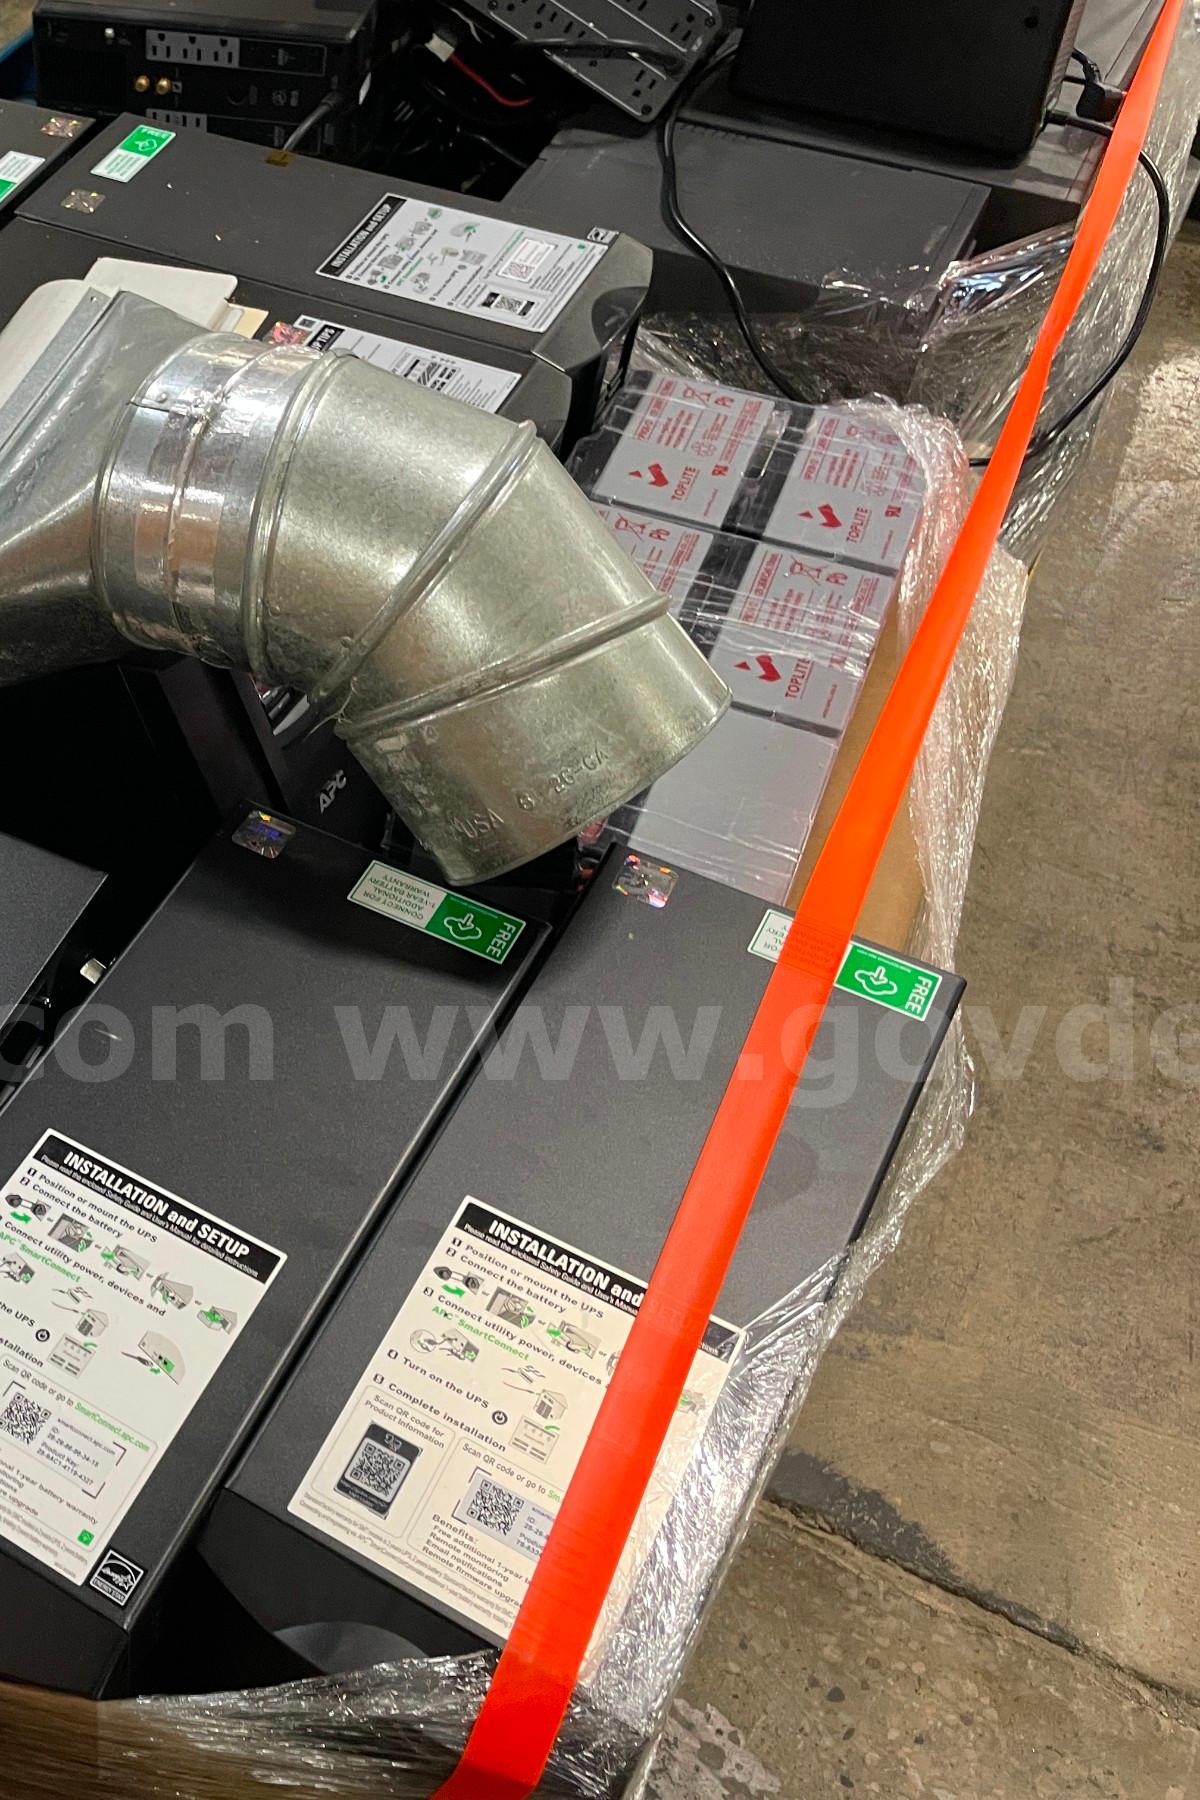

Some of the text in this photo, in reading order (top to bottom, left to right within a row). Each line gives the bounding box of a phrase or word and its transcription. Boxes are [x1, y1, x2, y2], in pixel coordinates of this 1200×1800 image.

[670, 465, 697, 501] TOPLITE
[845, 506, 868, 543] TOPLITE
[319, 769, 347, 814] APC
[361, 890, 424, 920] CONNECT FOR
[368, 876, 435, 908] 1-YEAR BATTERY
[371, 886, 424, 911] ADDITIONAL
[381, 874, 431, 898] WARRANTY
[485, 921, 516, 957] FREE
[904, 974, 933, 1014] FREE
[30, 1183, 125, 1239] Connect the battery
[37, 1173, 159, 1243] Position or mount the UPS
[61, 1151, 252, 1261] INSTALLATION and SETUP
[2, 1220, 167, 1317] Connect utility power, devices and
[18, 1242, 82, 1282] SmartConnect
[458, 1253, 567, 1315] Connect the battery
[464, 1243, 605, 1320] Position or mount the UPS
[486, 1219, 645, 1308] INSTALLATION and
[538, 1260, 562, 1278] Safety
[15, 1312, 36, 1328] UPS
[436, 1293, 602, 1388] Connect utility power, devices
[456, 1317, 530, 1362] SmartConnect
[1, 1359, 151, 1453] Scan QR code or go to SmartConnect.apc.com
[401, 1355, 489, 1410] Turn on the UPS
[363, 1398, 445, 1450] Product Information
[373, 1393, 445, 1438] Scan QR code for
[387, 1381, 507, 1454] Complete installation
[14, 1468, 38, 1487] 1-year
[36, 1483, 64, 1504] battery
[461, 1441, 547, 1495] Scan QR code or go to
[431, 1512, 478, 1546] Benefits:
[432, 1523, 454, 1541] Free
[453, 1535, 496, 1566] additional
[494, 1560, 523, 1582] 1-year
[421, 1545, 492, 1592] Remote firmware
[425, 1537, 503, 1589] Email notifications
[429, 1530, 509, 1585] Remote monitoring
